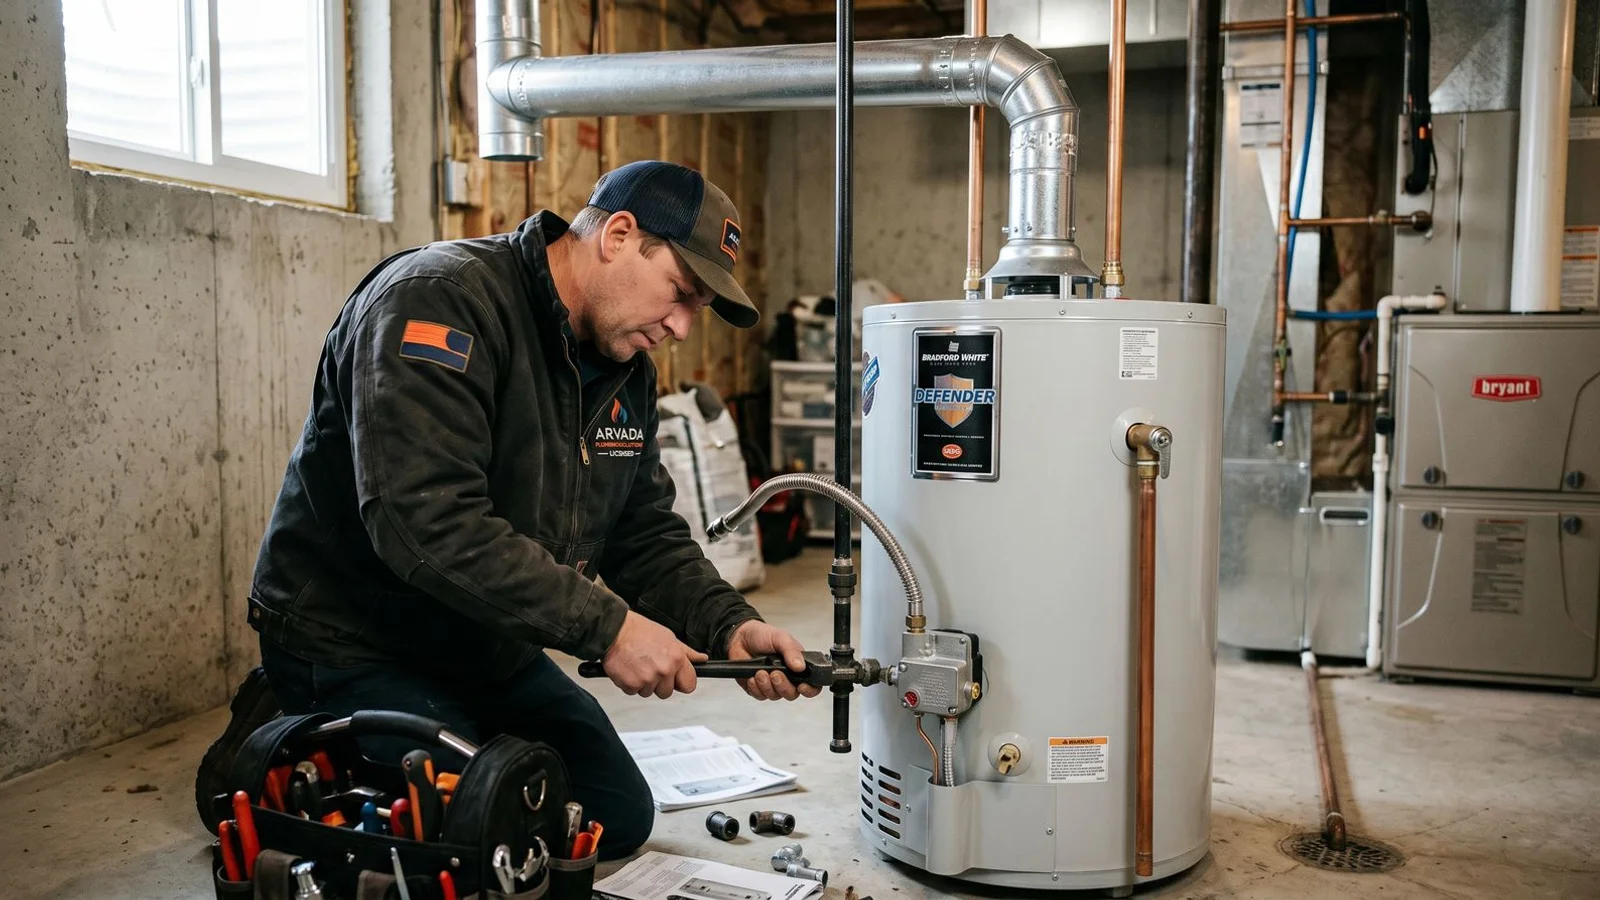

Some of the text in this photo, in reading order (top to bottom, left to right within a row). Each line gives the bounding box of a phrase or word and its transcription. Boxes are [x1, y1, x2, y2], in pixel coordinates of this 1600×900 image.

[922, 353, 960, 361] BRADFORD
[1482, 380, 1530, 396] bryant
[915, 389, 995, 403] DEFENDER
[596, 428, 643, 440] ARVADA
